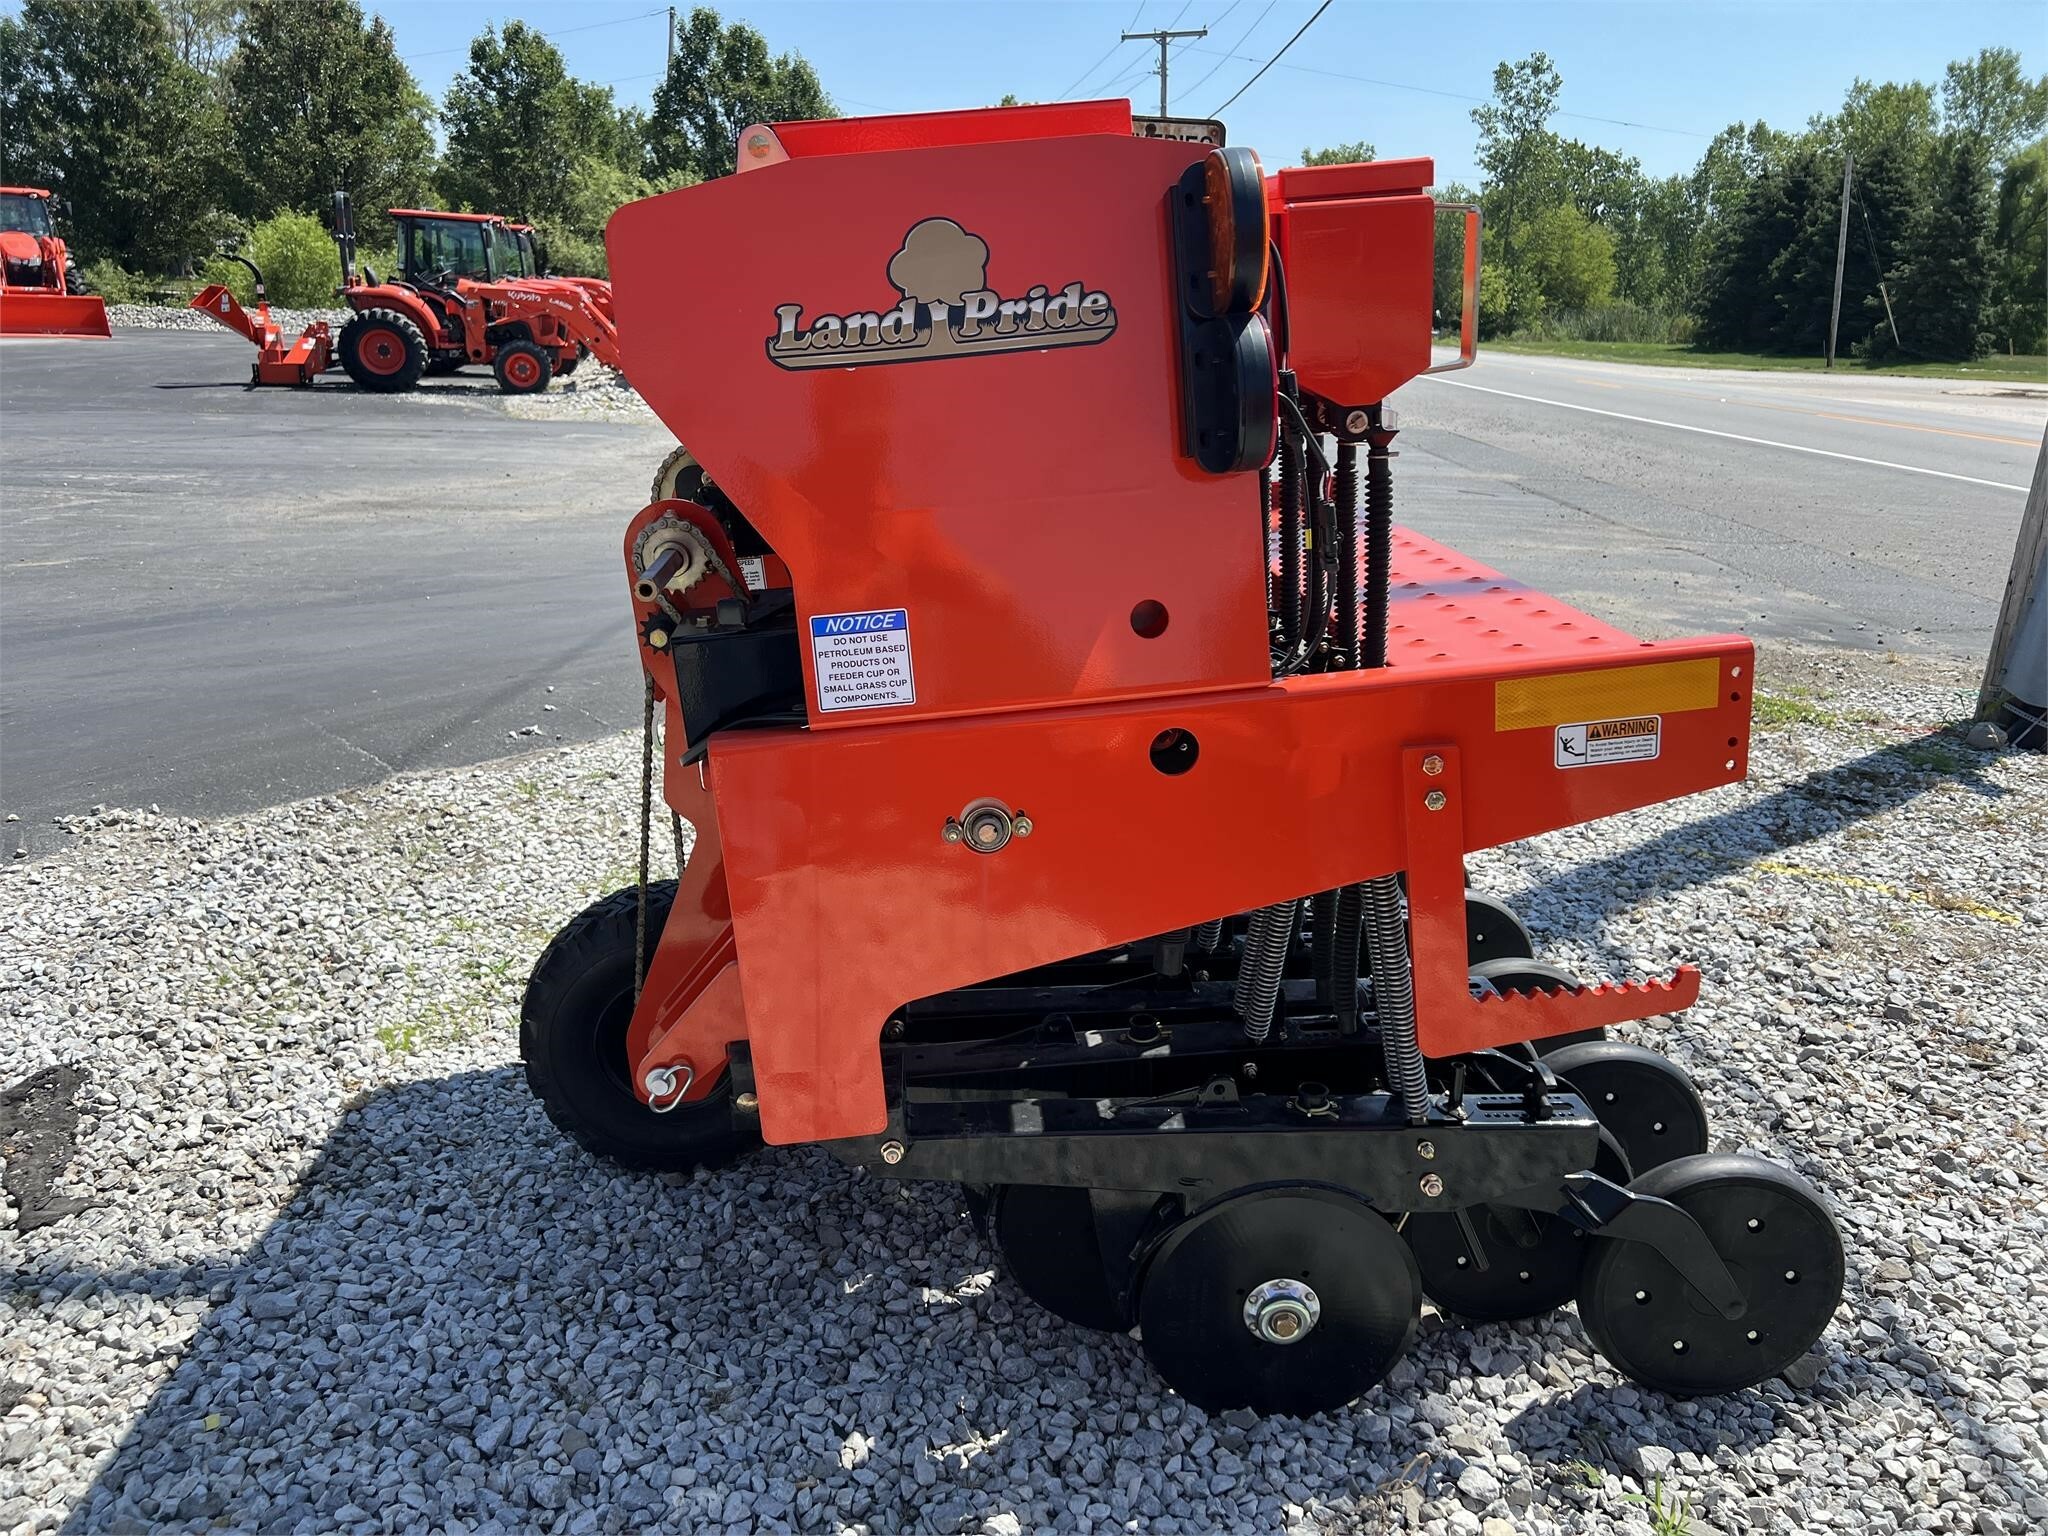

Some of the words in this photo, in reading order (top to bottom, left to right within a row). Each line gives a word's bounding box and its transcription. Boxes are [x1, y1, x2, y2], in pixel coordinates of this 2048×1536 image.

[507, 290, 541, 302] Kubota
[773, 297, 919, 350] Land
[957, 281, 1110, 338] Pride
[825, 613, 897, 633] NOTICE
[833, 637, 847, 646] DO
[849, 635, 867, 645] NOT
[870, 634, 889, 643] USE
[818, 647, 873, 659] PETROLEUM
[875, 644, 906, 654] BASED
[831, 658, 880, 669] PRODUCTS
[882, 656, 896, 665] ON
[828, 671, 864, 681] FEEDER
[866, 669, 885, 678] CUP
[887, 668, 900, 677] OR
[823, 683, 854, 694] SMALL
[855, 680, 887, 691] GRASS
[889, 679, 908, 688] CUP
[1601, 720, 1655, 737] WARNING
